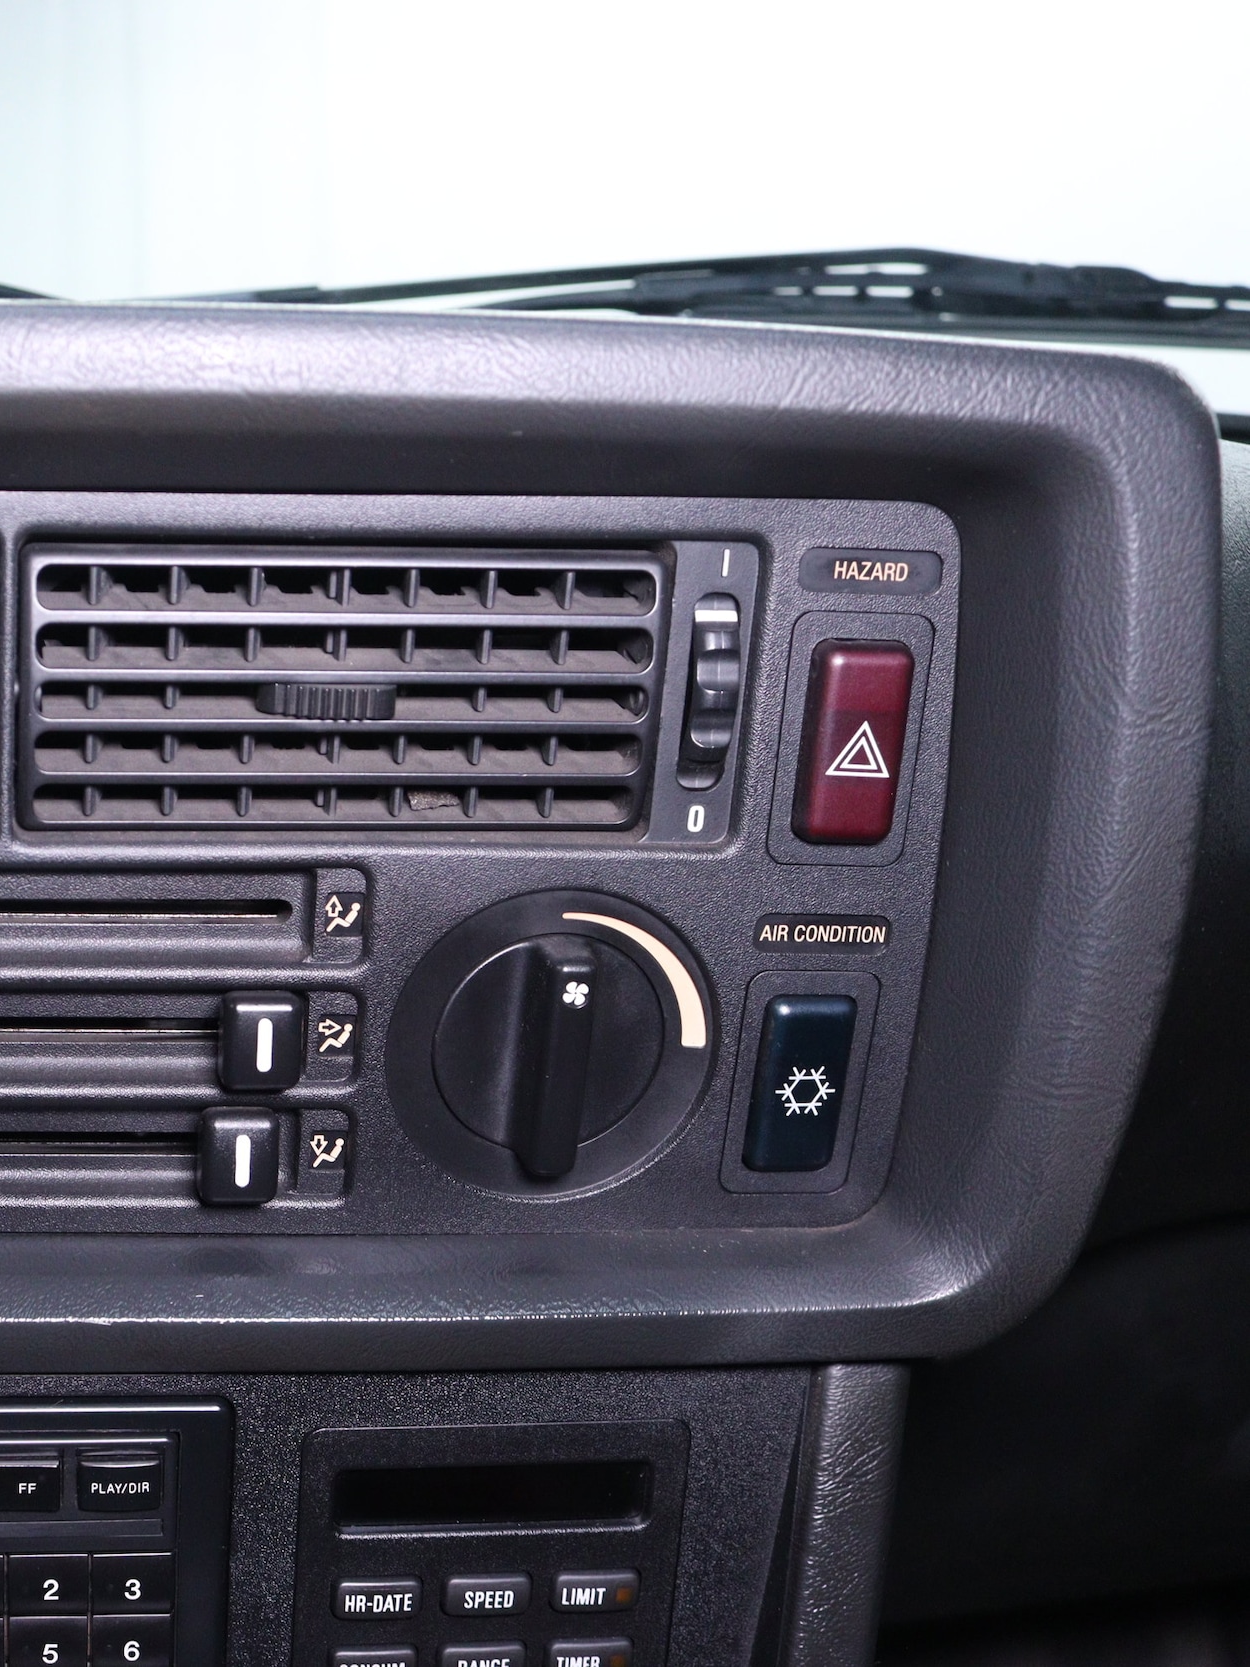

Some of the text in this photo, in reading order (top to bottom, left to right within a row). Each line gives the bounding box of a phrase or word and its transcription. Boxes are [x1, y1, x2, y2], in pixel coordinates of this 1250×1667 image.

[833, 560, 909, 582] HAZARD
[759, 924, 886, 943] AIR CONDITION
[18, 1482, 37, 1495] FF
[91, 1481, 150, 1495] PLAY/DIR
[42, 1579, 60, 1601] 2
[124, 1579, 142, 1601] 3
[463, 1590, 515, 1609] SPEED
[561, 1587, 607, 1606] LIMIT
[344, 1593, 413, 1613] HR-DATE
[42, 1643, 59, 1665] 5
[123, 1640, 140, 1662] 6
